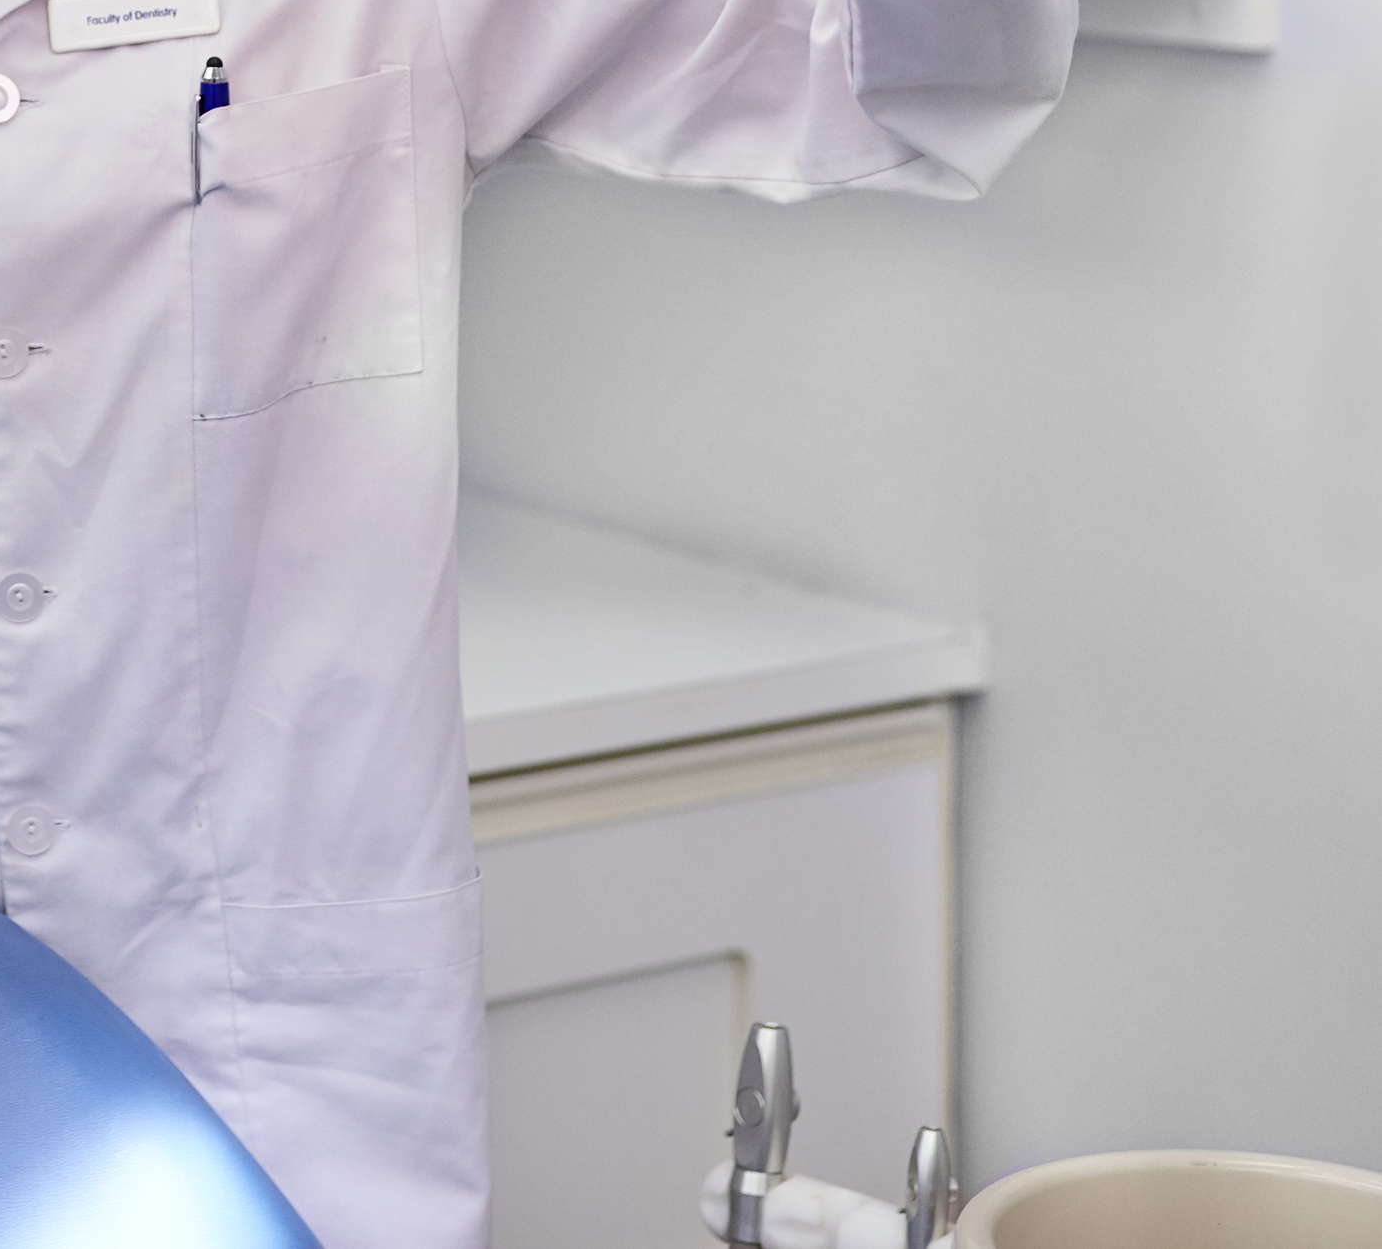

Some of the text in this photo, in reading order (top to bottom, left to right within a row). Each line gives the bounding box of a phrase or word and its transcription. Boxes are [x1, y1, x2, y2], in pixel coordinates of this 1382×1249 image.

[86, 7, 177, 25] Faculty of Dentistry
